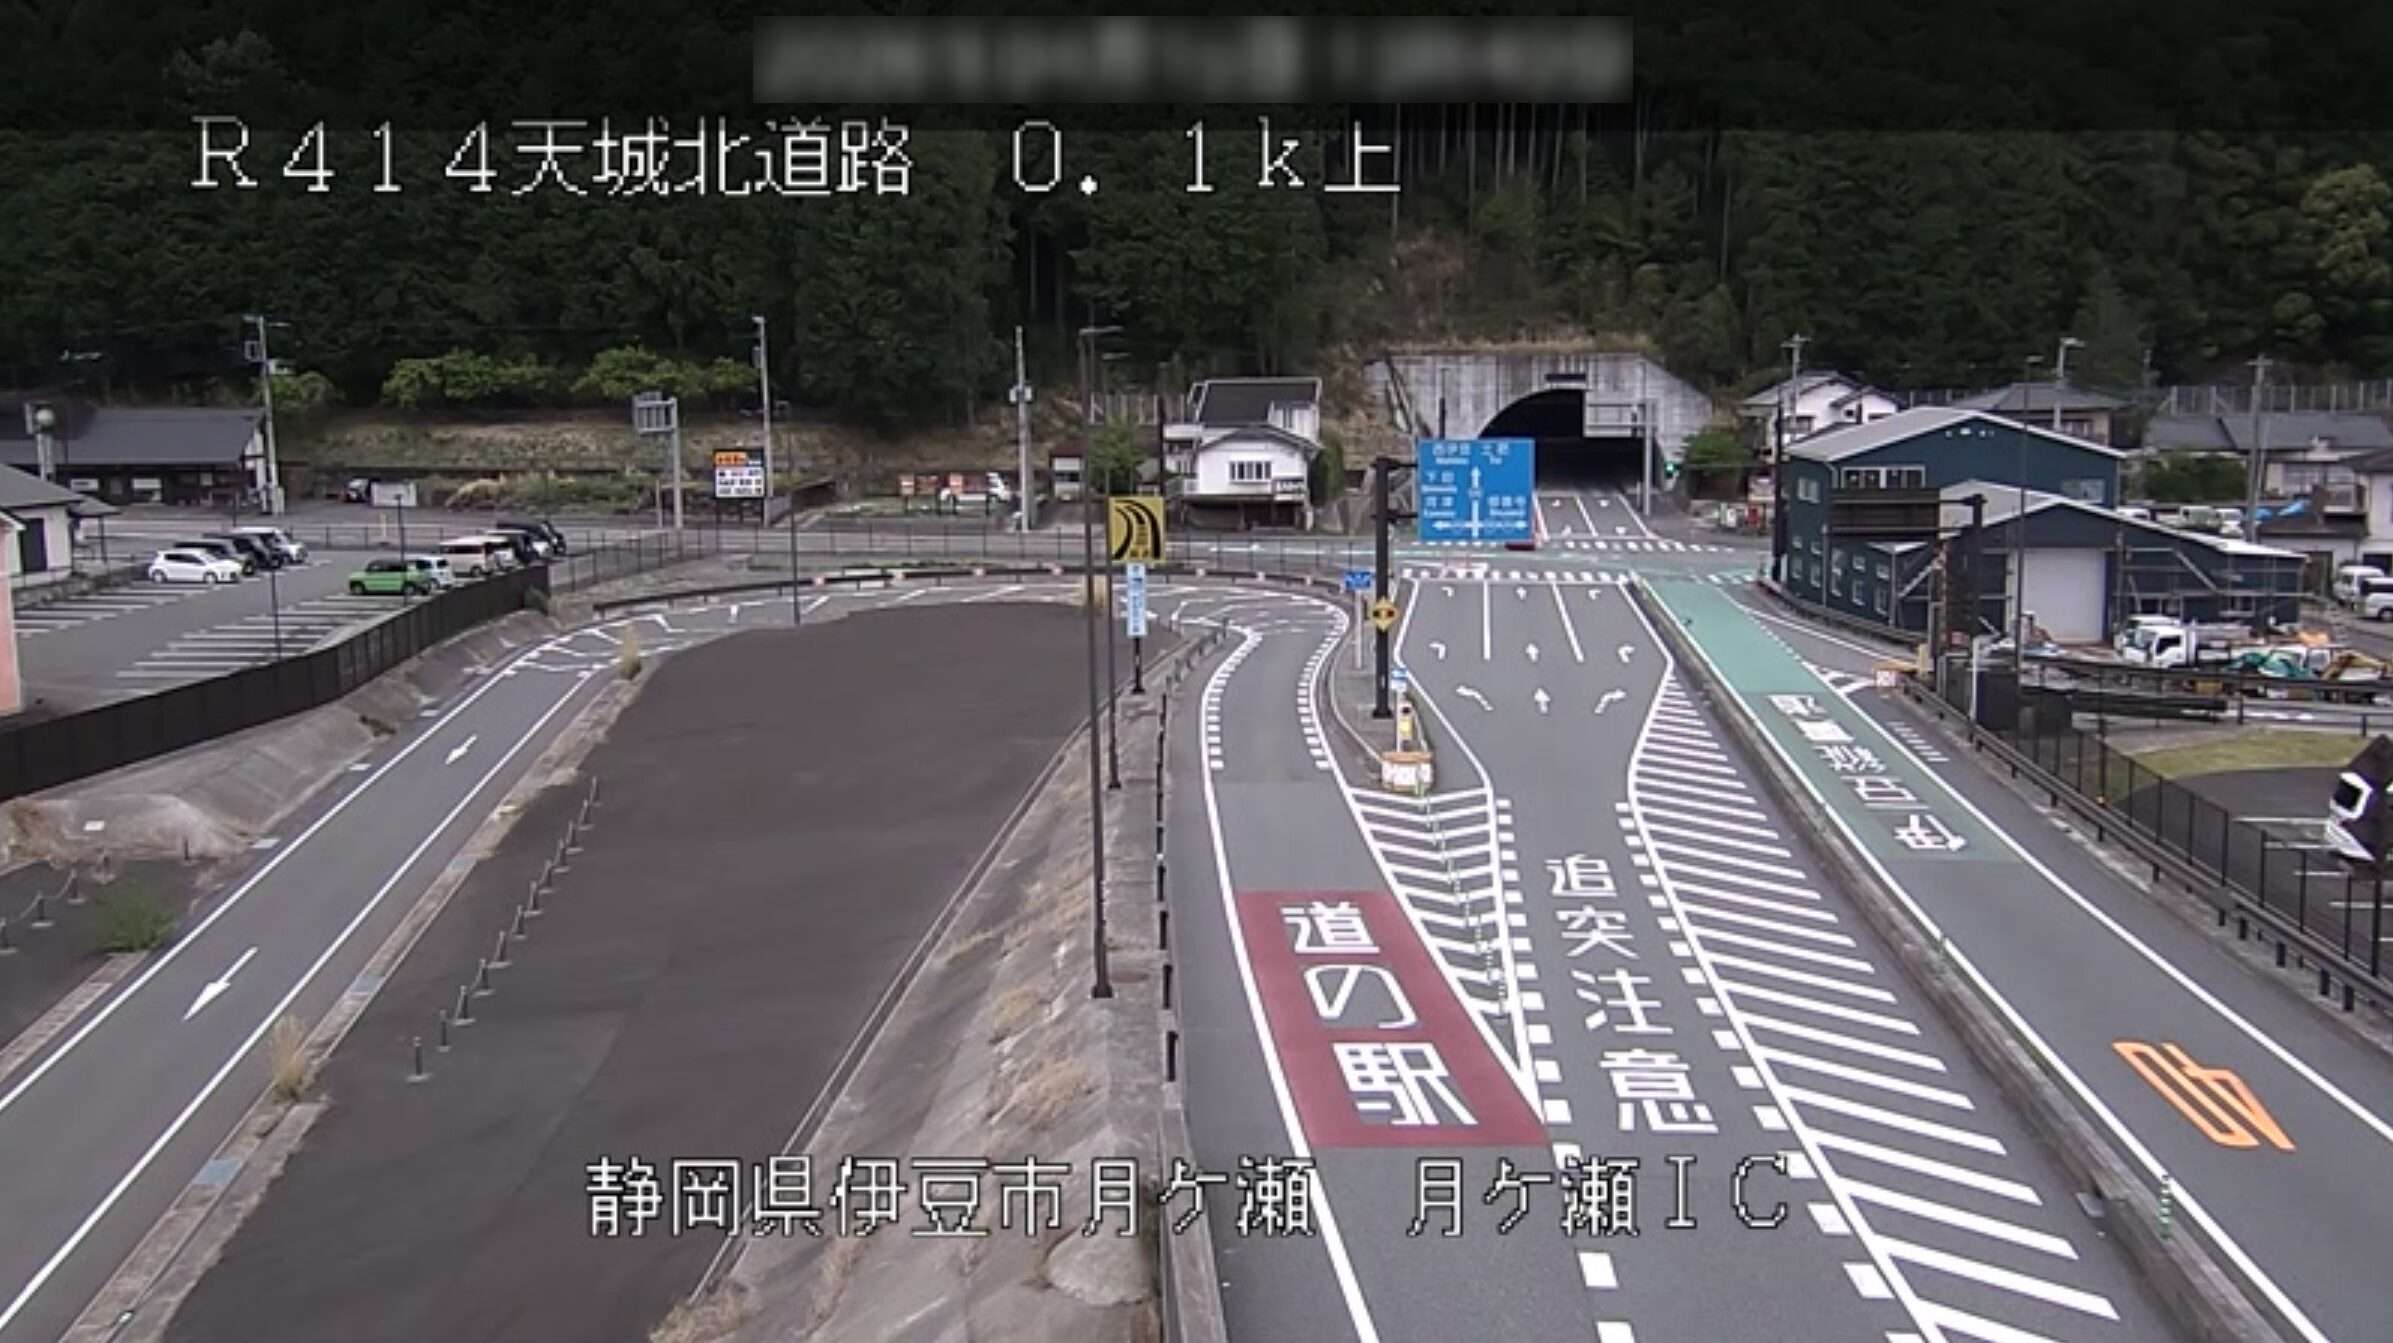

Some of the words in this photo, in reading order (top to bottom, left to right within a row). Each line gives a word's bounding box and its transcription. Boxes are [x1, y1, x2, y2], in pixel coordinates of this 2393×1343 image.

[1280, 900, 1478, 1128] 道の駅
[1544, 852, 1720, 1135] 追突注意
